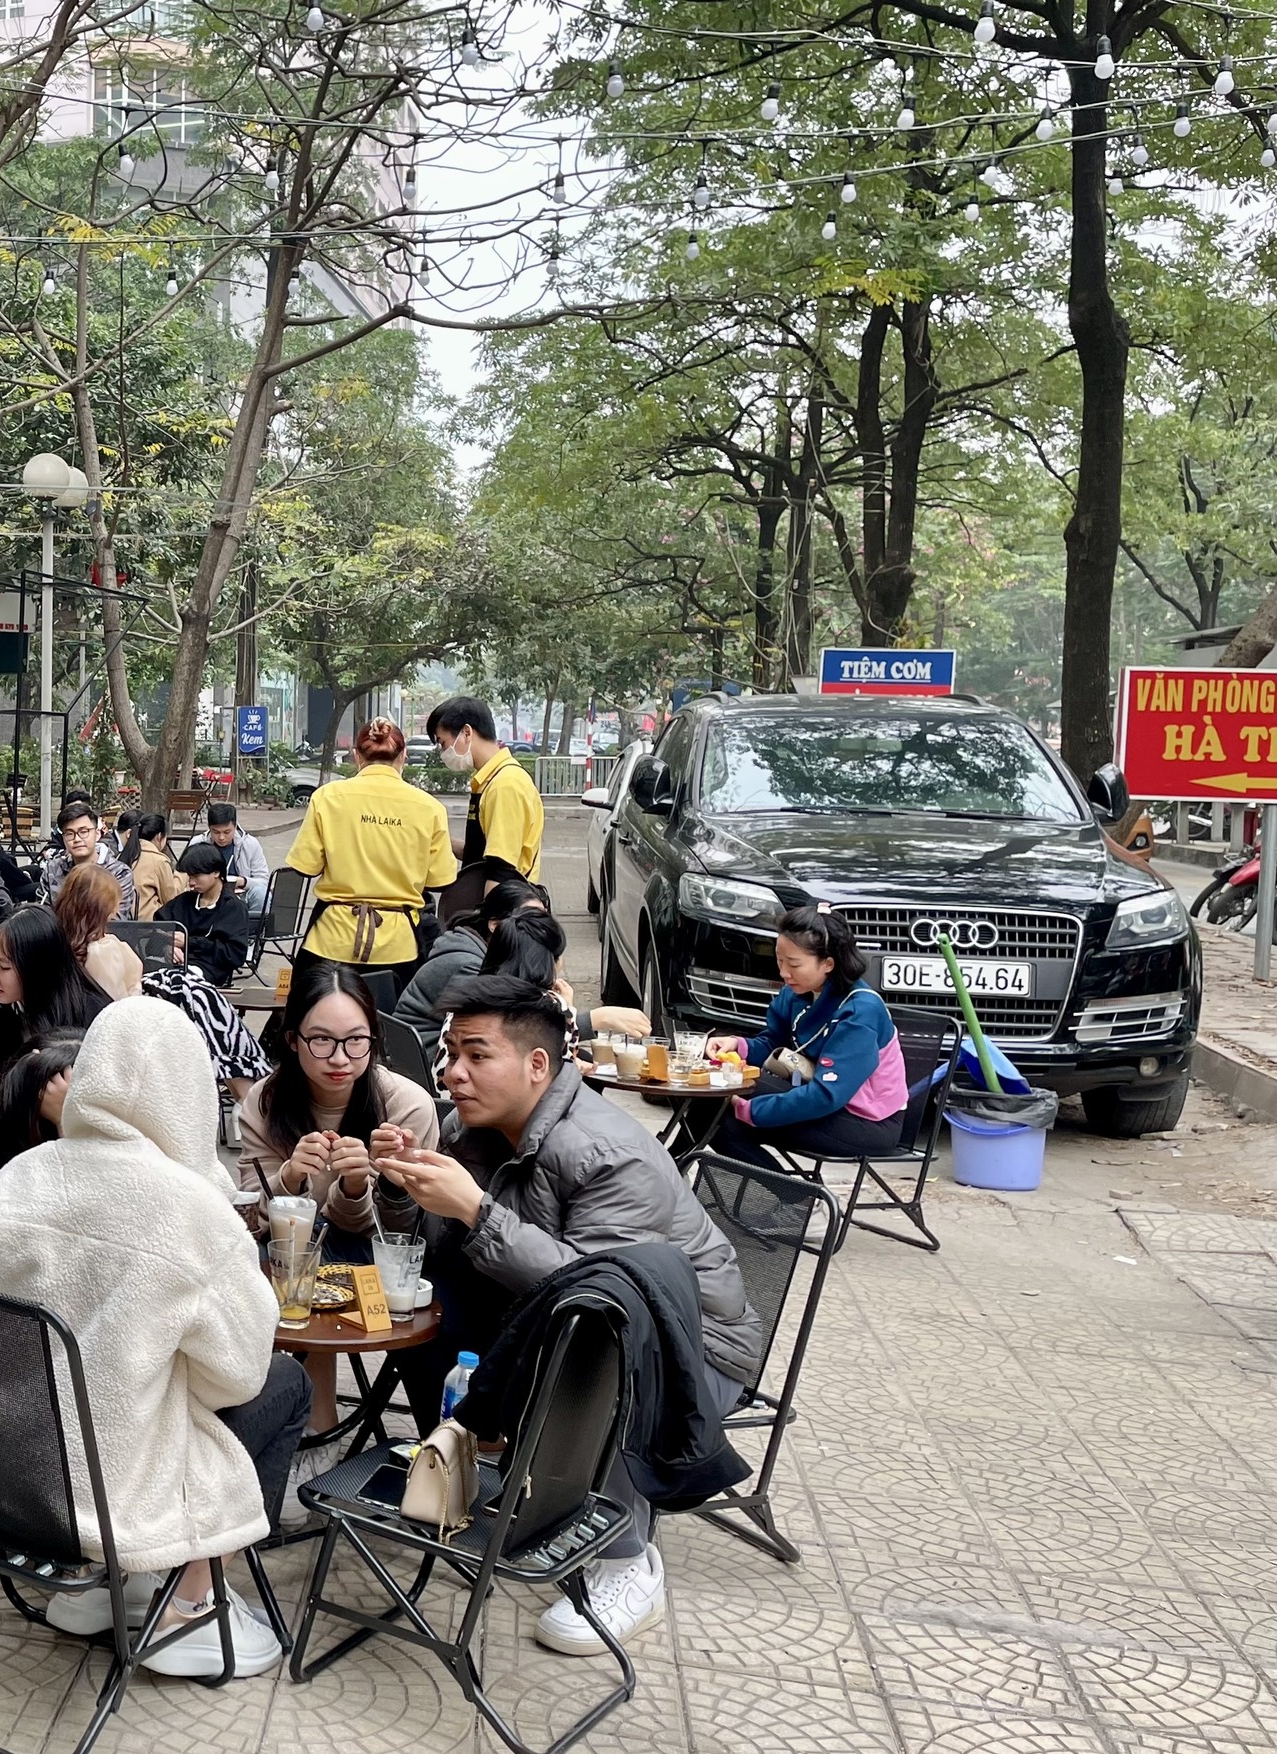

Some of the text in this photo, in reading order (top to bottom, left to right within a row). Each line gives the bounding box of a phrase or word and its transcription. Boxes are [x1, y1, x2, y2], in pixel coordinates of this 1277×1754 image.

[840, 656, 933, 683] TIỆM CƠM
[1137, 672, 1276, 713] VĂN PHÒNG
[242, 723, 263, 731] CAFÉ
[241, 732, 264, 745] Kem
[1162, 715, 1227, 762] HÀ
[378, 816, 403, 827] LAIKA
[366, 1303, 387, 1316] A52
